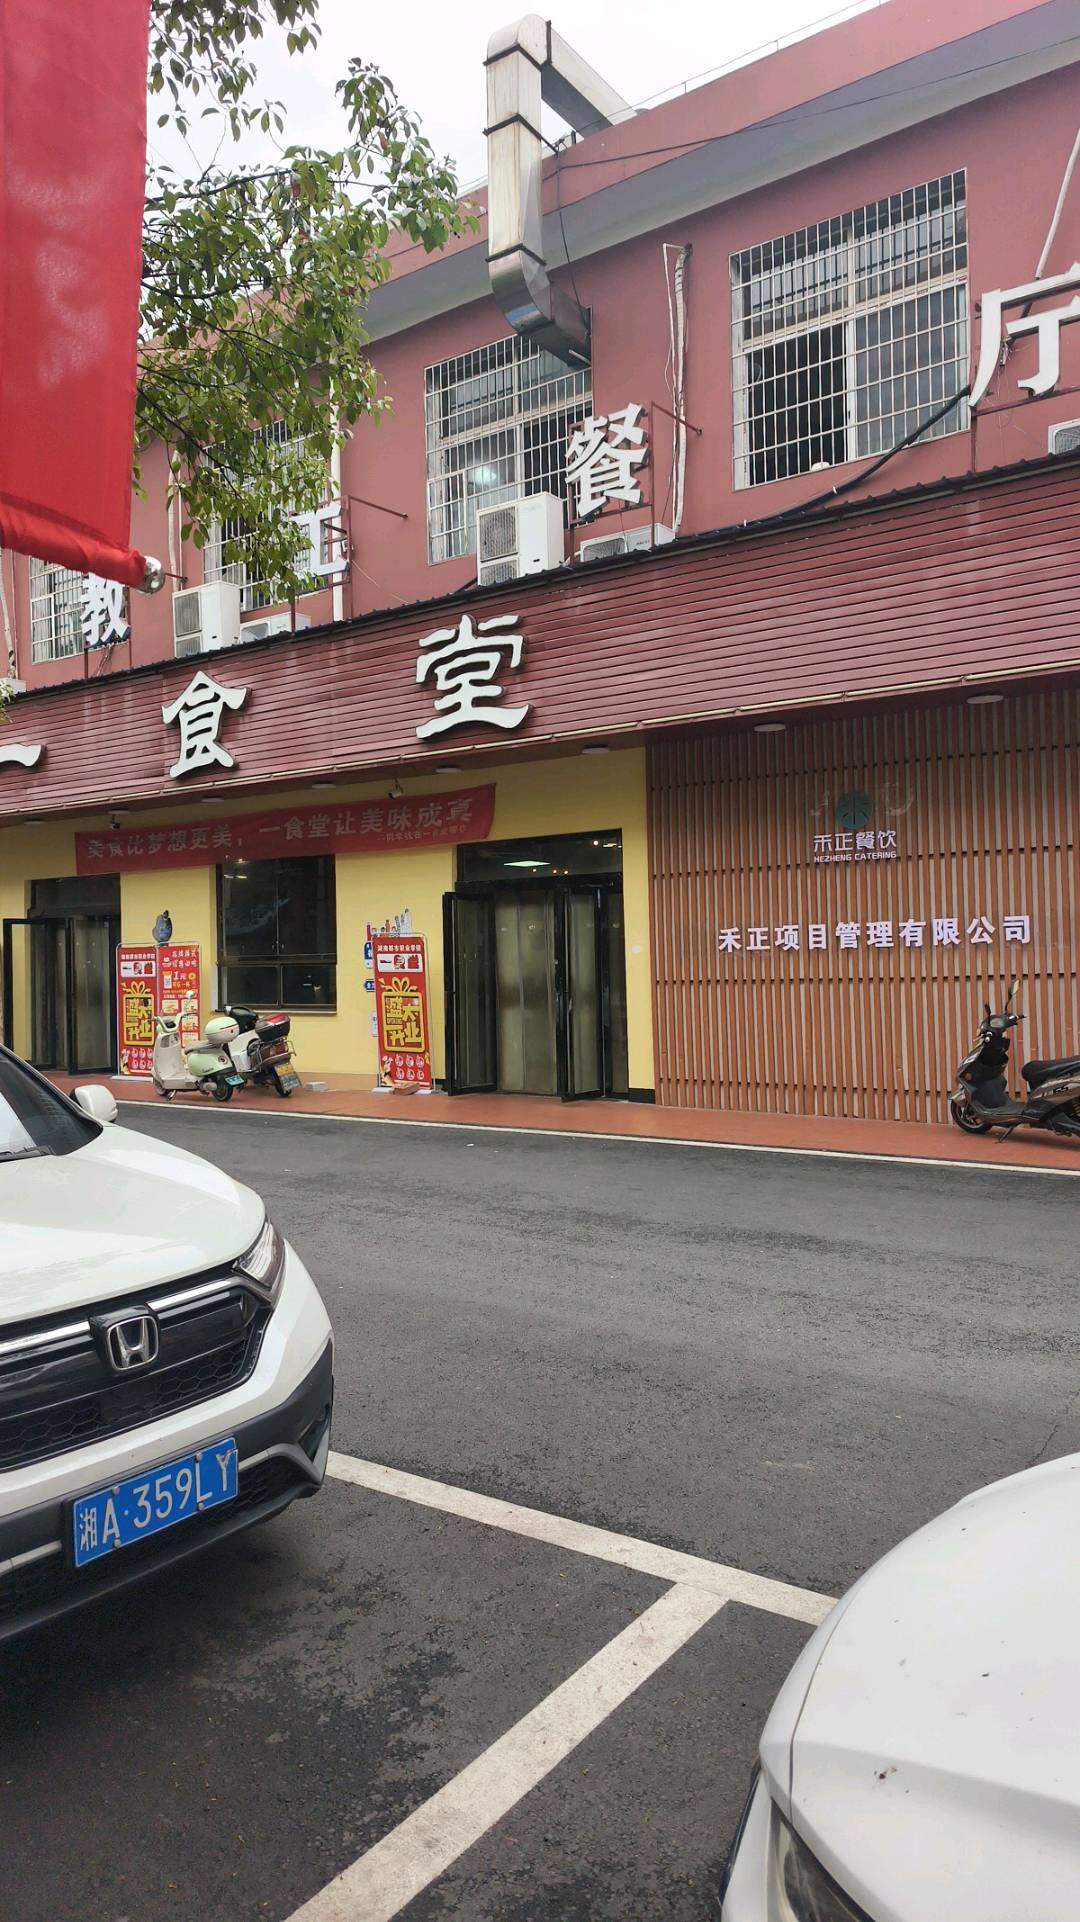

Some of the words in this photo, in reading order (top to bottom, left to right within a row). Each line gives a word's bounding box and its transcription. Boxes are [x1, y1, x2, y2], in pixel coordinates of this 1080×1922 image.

[813, 830, 897, 853] 禾正餐饮
[854, 851, 897, 861] CATERING
[718, 914, 1032, 953] 禾正项目管理有限公司
